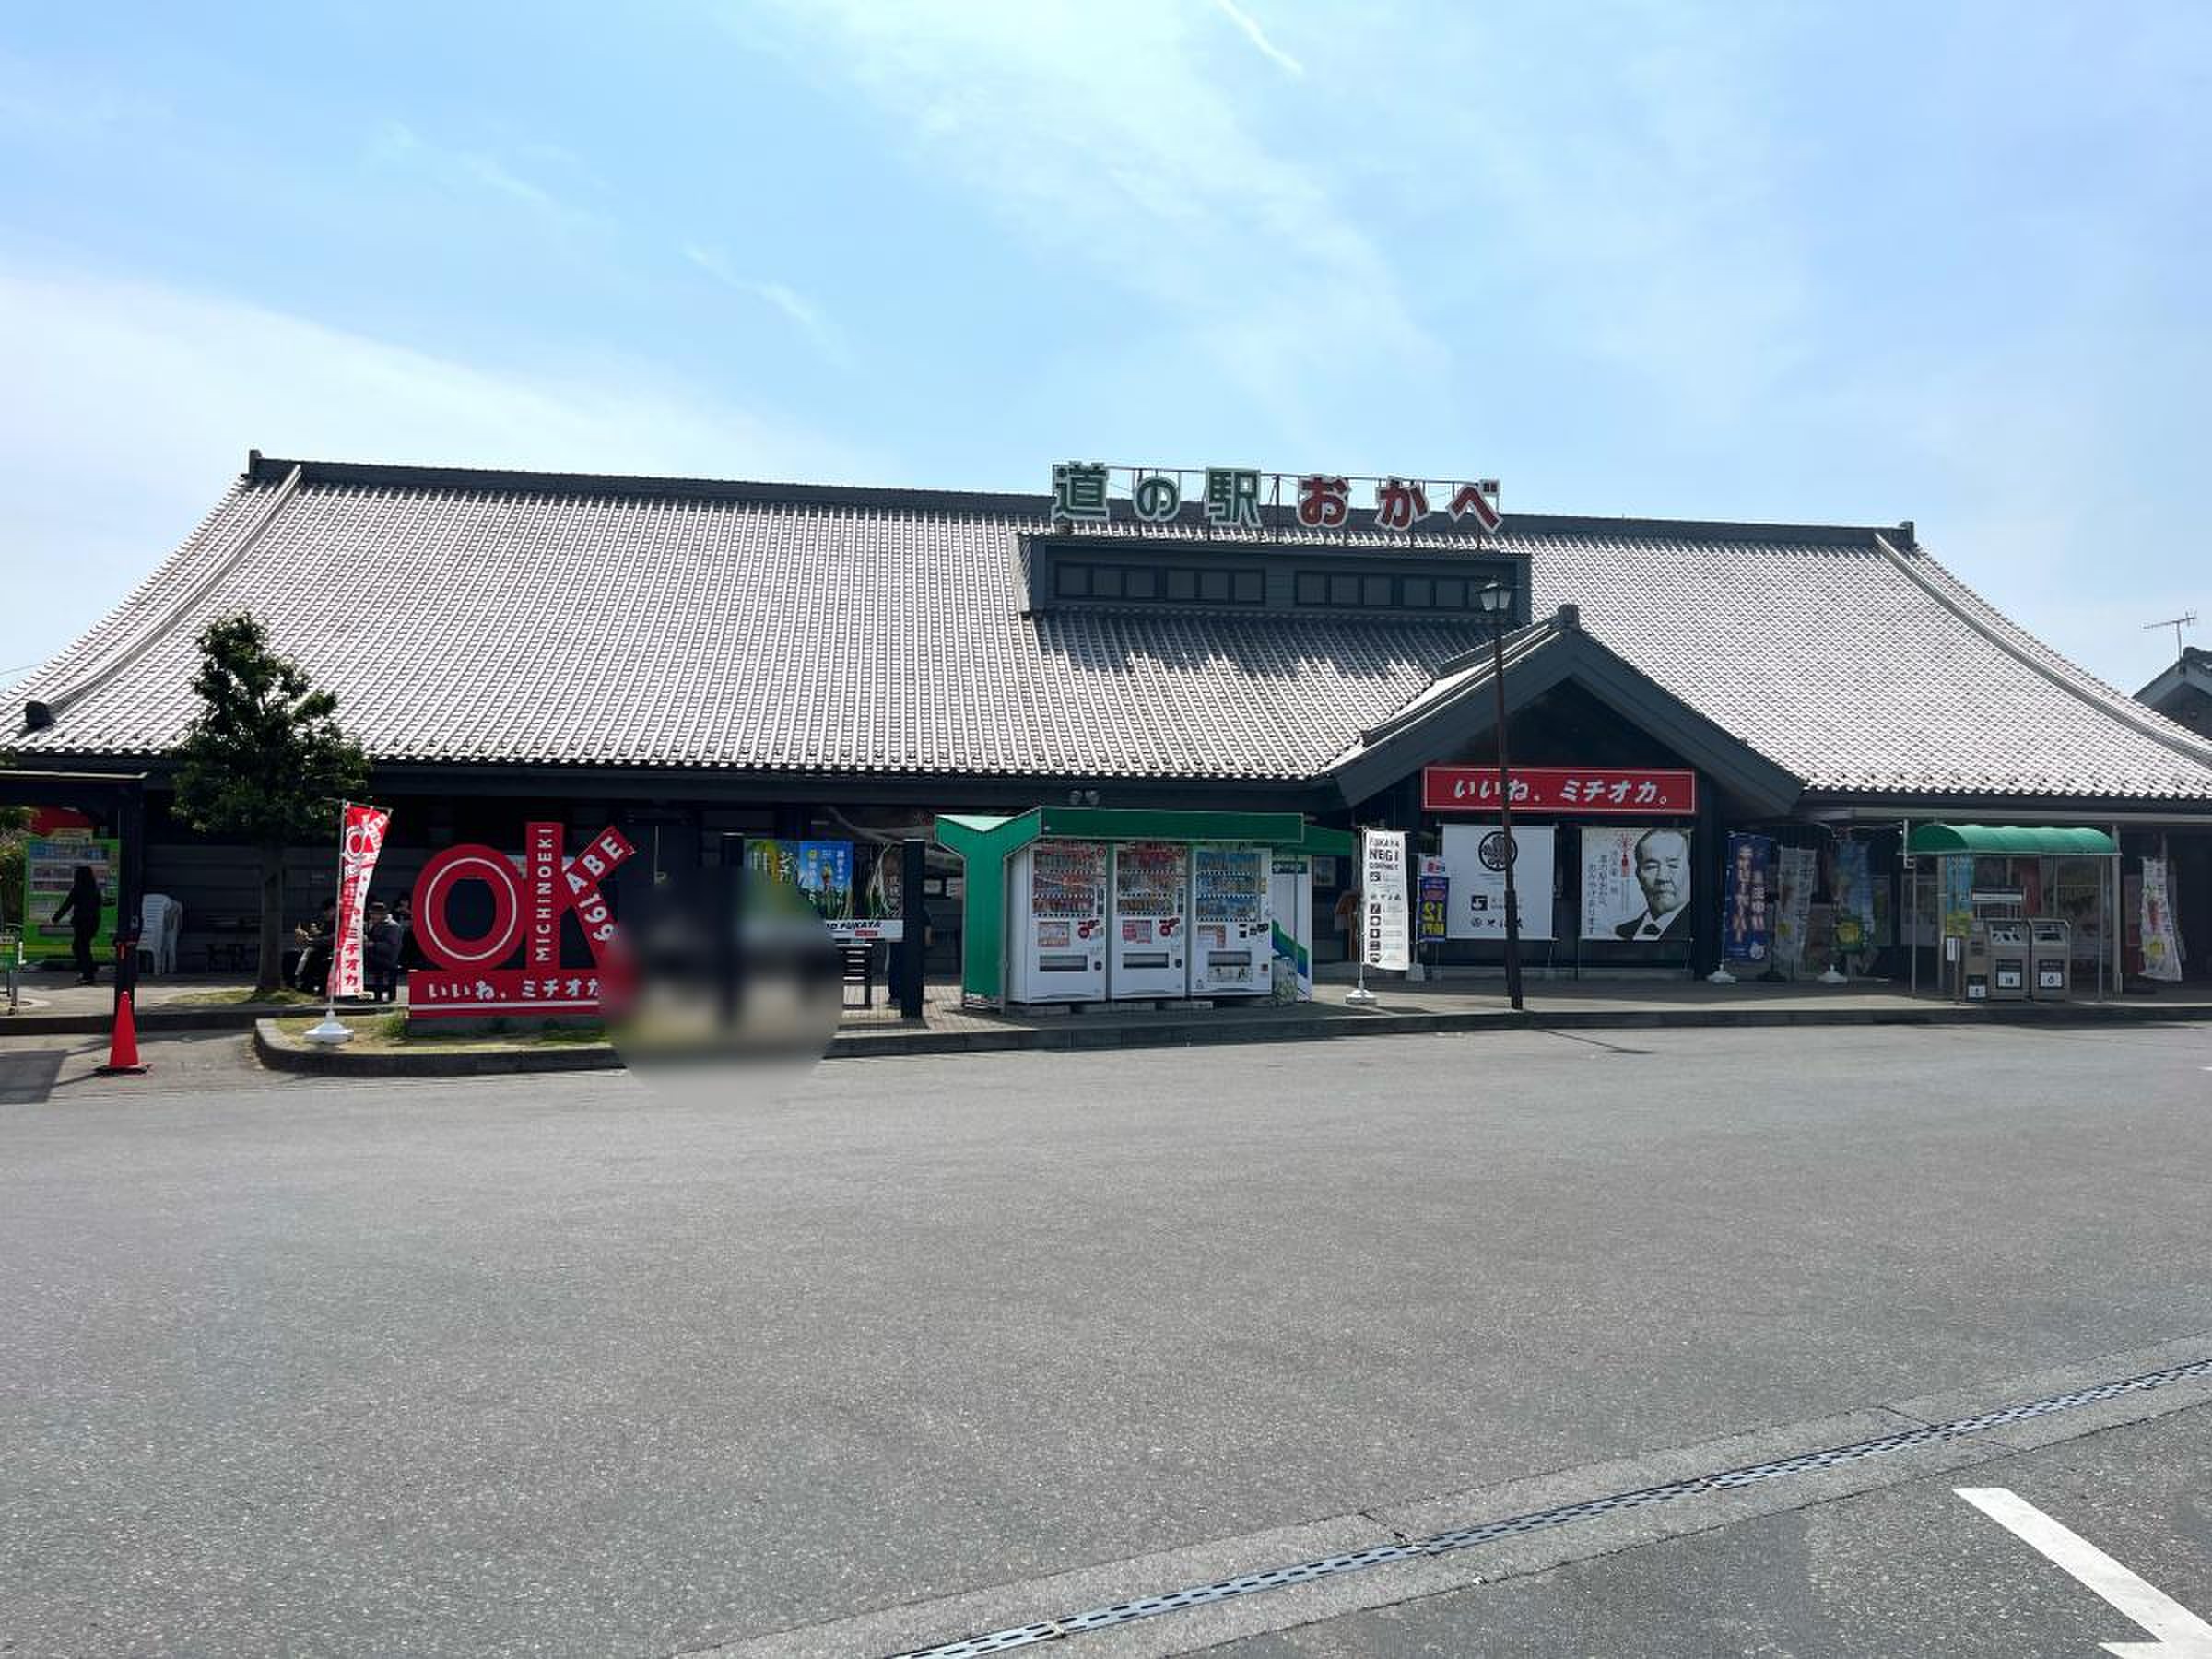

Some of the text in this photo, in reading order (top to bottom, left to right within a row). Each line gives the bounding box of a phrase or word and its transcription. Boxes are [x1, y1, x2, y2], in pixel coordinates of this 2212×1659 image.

[1052, 460, 1504, 534] 道の駅おかべ
[1369, 848, 1400, 862] NEGI
[535, 828, 554, 962] MICHINOEKI
